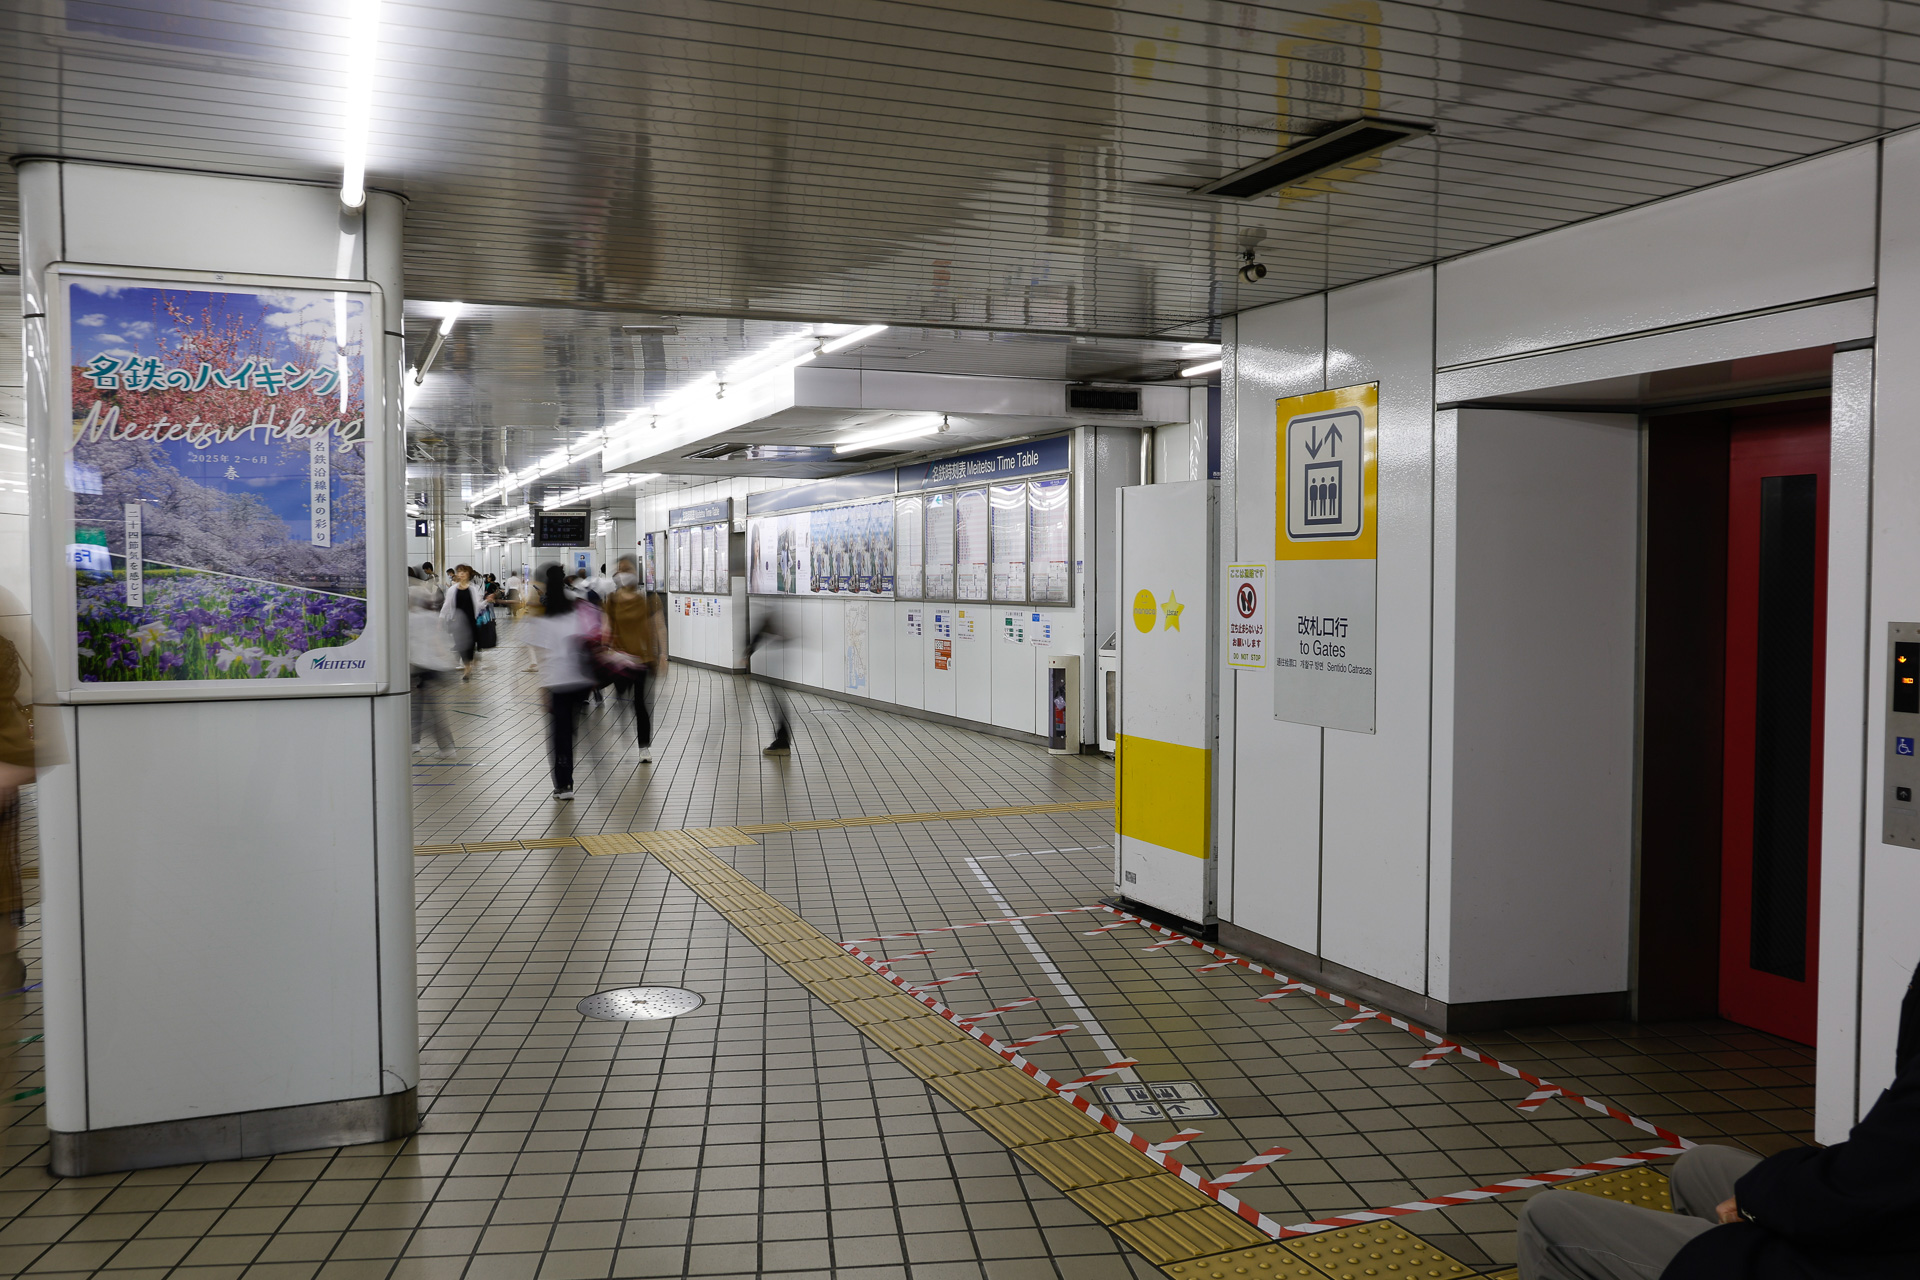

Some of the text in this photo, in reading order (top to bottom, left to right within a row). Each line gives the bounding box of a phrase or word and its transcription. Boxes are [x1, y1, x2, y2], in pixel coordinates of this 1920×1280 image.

[84, 354, 350, 396] 名鉄のハイキング
[66, 399, 371, 453] Meitetsu Hiking
[192, 454, 229, 463] 2025年
[932, 450, 1039, 482] 名鉄時刻表 Meitetsu Time Table
[223, 465, 240, 480] 春
[314, 441, 327, 541] 名鉄沿線春の彩り
[418, 522, 426, 534] 1
[128, 510, 140, 601] 二十四節気を感じて
[1298, 616, 1348, 638] 改札口行
[1300, 639, 1346, 658] to Gates
[310, 654, 366, 670] MEITETSU
[1326, 661, 1347, 673] Sentido
[1347, 663, 1372, 676] Catracas
